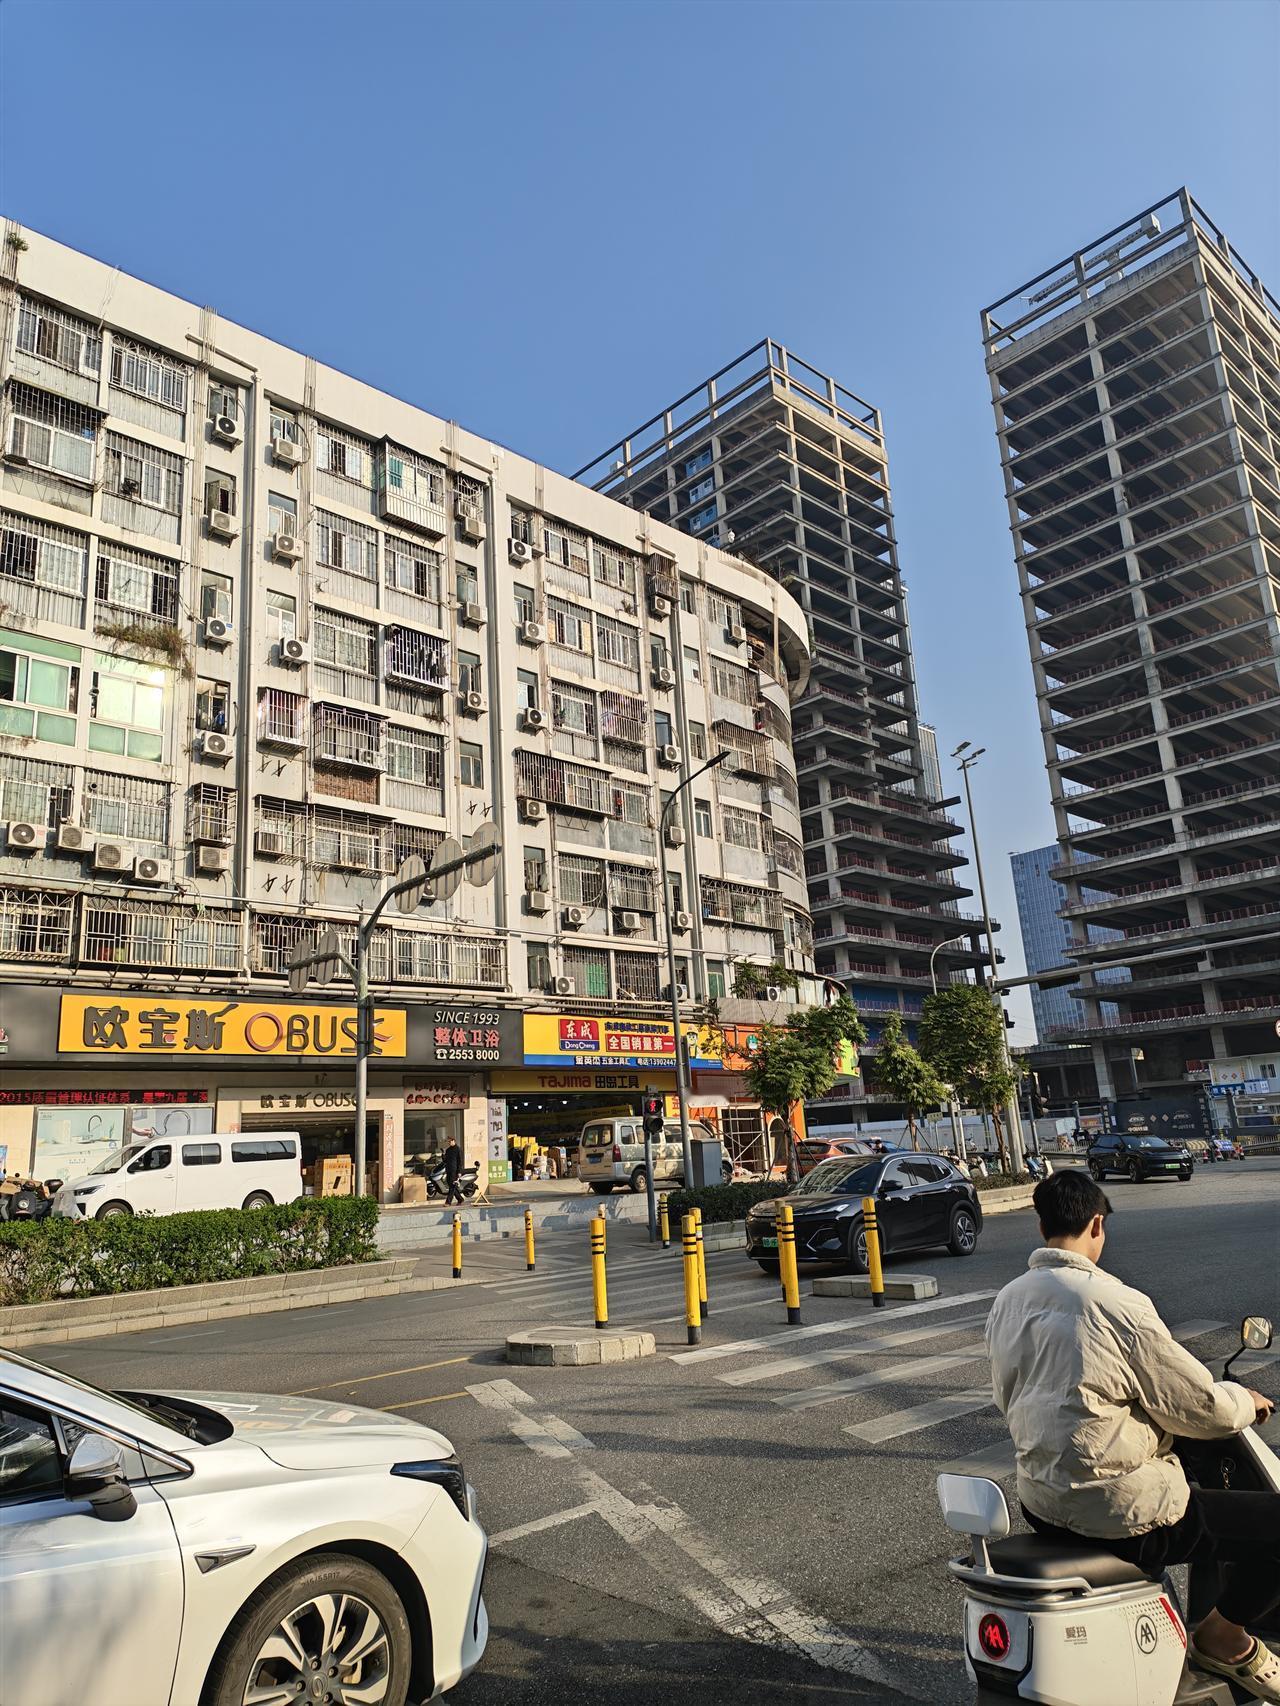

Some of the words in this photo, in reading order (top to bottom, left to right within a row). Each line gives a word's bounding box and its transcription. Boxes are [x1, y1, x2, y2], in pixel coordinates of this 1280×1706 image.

[434, 1010, 470, 1023] SINCE
[473, 1012, 499, 1025] 1993
[83, 1003, 239, 1050] 欧宝斯
[566, 1020, 592, 1039] 东成
[434, 1027, 499, 1048] 整体卫浴
[608, 1035, 674, 1051] 全国销量第一
[449, 1048, 474, 1060] 2553
[476, 1049, 499, 1060] 8000
[575, 1055, 601, 1066] 金英杰
[595, 1075, 640, 1089] 田岛工具
[260, 1092, 311, 1109] 欧宝斯
